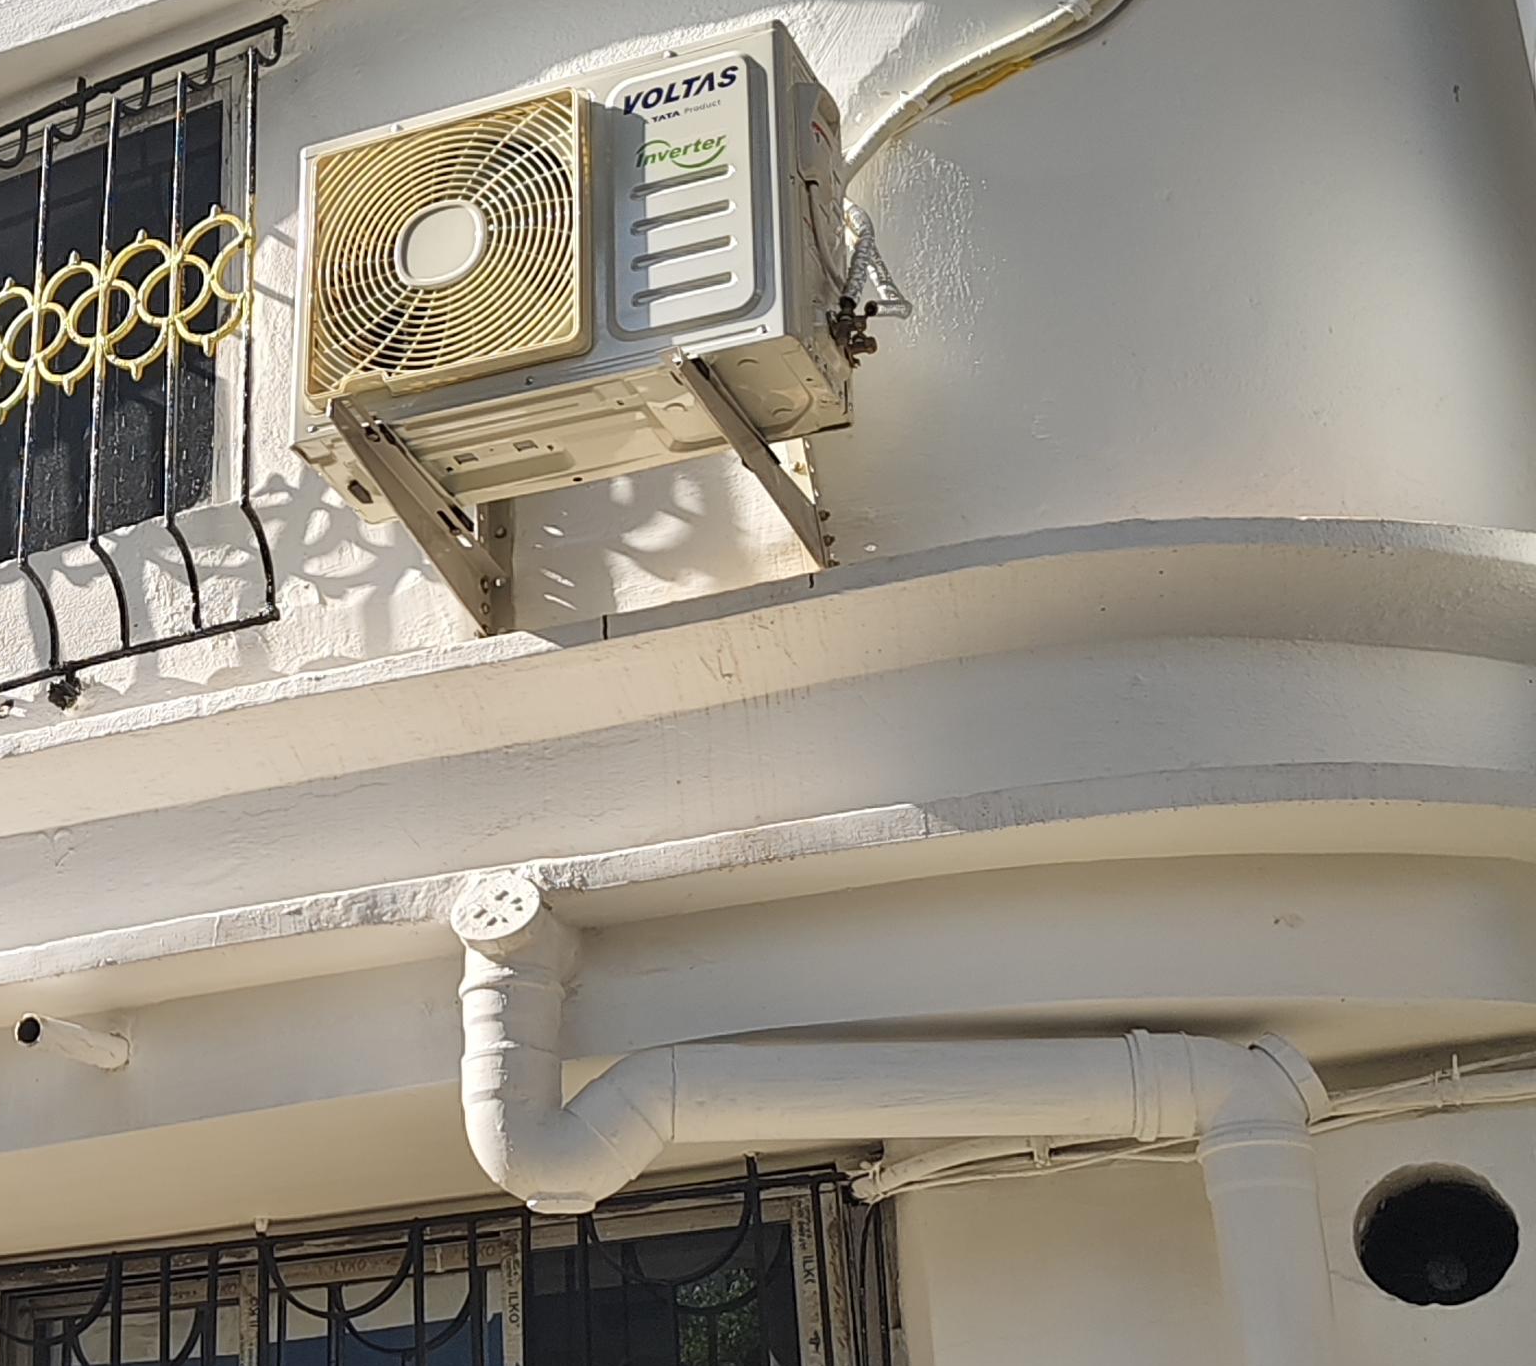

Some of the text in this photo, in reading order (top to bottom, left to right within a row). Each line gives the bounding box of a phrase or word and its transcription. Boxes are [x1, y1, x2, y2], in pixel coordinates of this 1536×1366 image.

[623, 65, 739, 115] VOLTAS
[651, 110, 680, 123] TATA
[684, 99, 721, 114] Product
